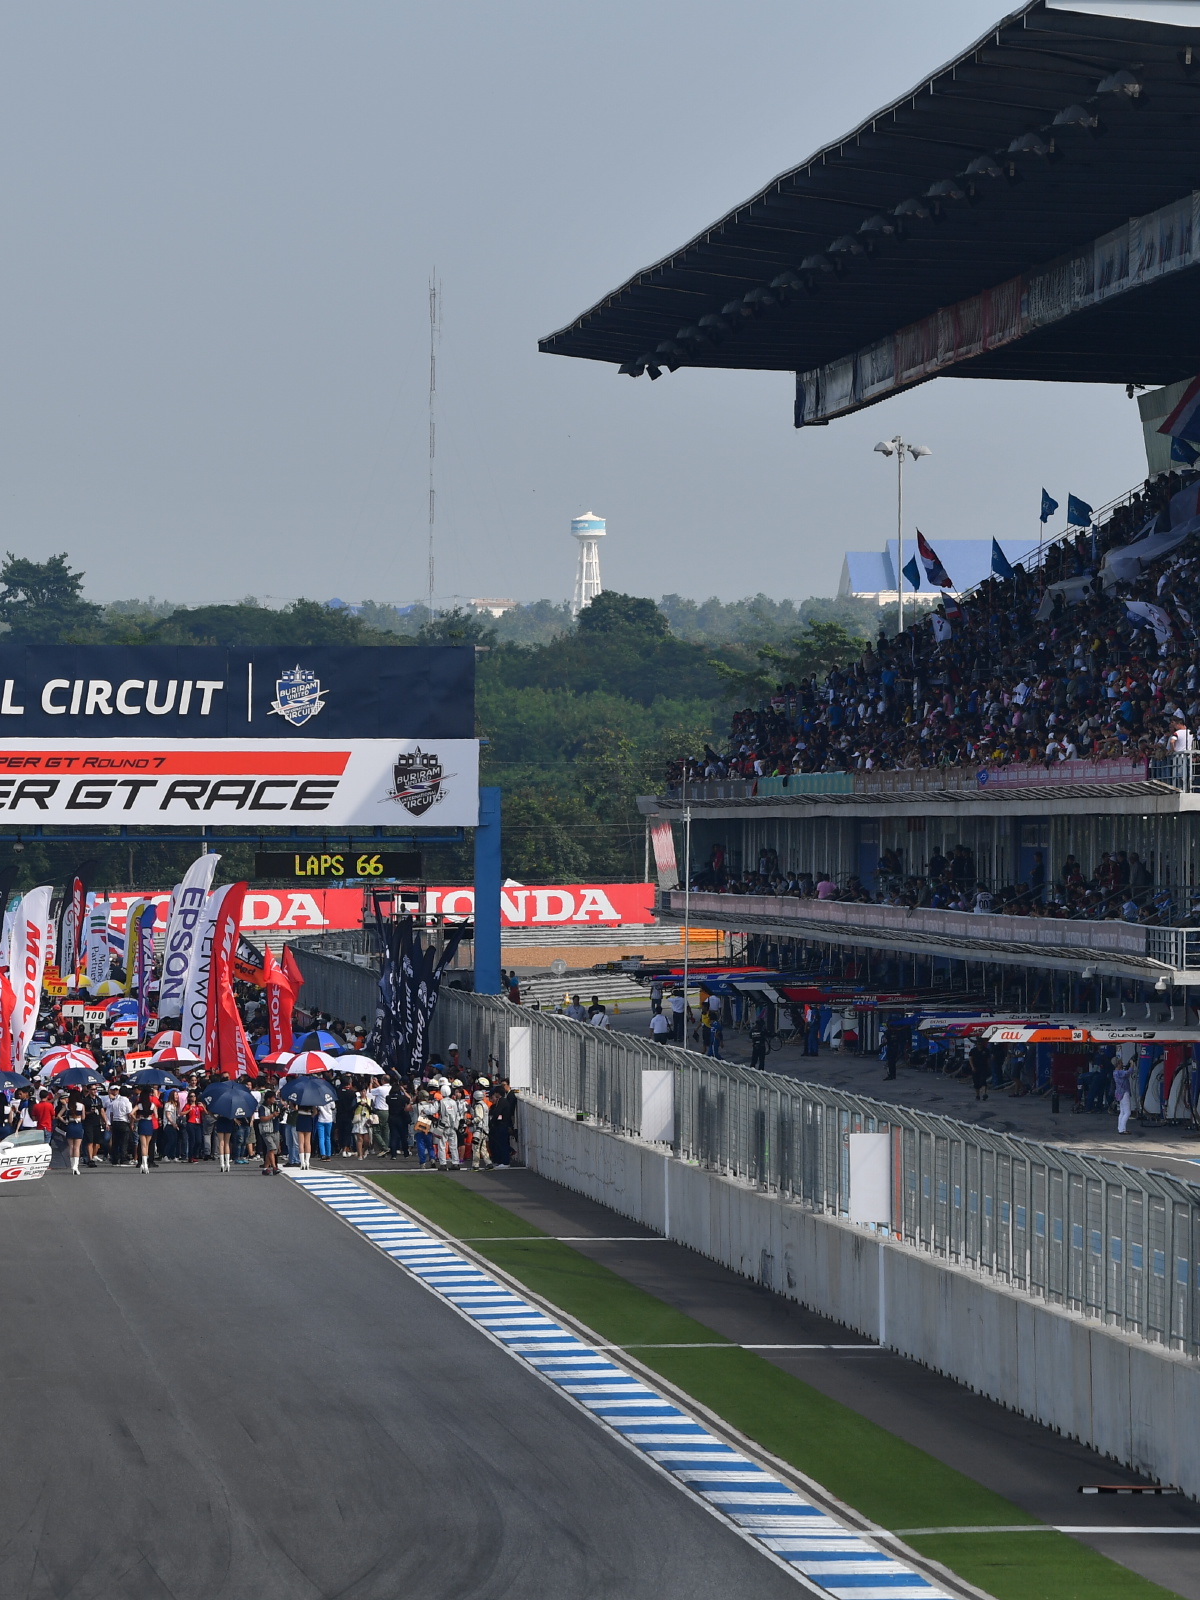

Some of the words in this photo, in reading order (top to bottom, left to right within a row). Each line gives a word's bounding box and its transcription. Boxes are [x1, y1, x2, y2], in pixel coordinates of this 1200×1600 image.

[280, 681, 317, 697] BURIRAM
[41, 679, 224, 716] CIRCUIT
[46, 756, 80, 768] GT
[152, 757, 167, 768] 7
[397, 767, 440, 784] BURIRAM
[66, 779, 158, 810] GT
[165, 779, 342, 811] RACE
[294, 854, 345, 876] LAPS
[356, 854, 384, 876] 66
[162, 887, 206, 999] EPSON
[52, 986, 62, 994] 18
[85, 1012, 104, 1020] 100
[111, 1037, 118, 1046] 6
[1001, 1031, 1023, 1040] au
[132, 1059, 146, 1069] 15
